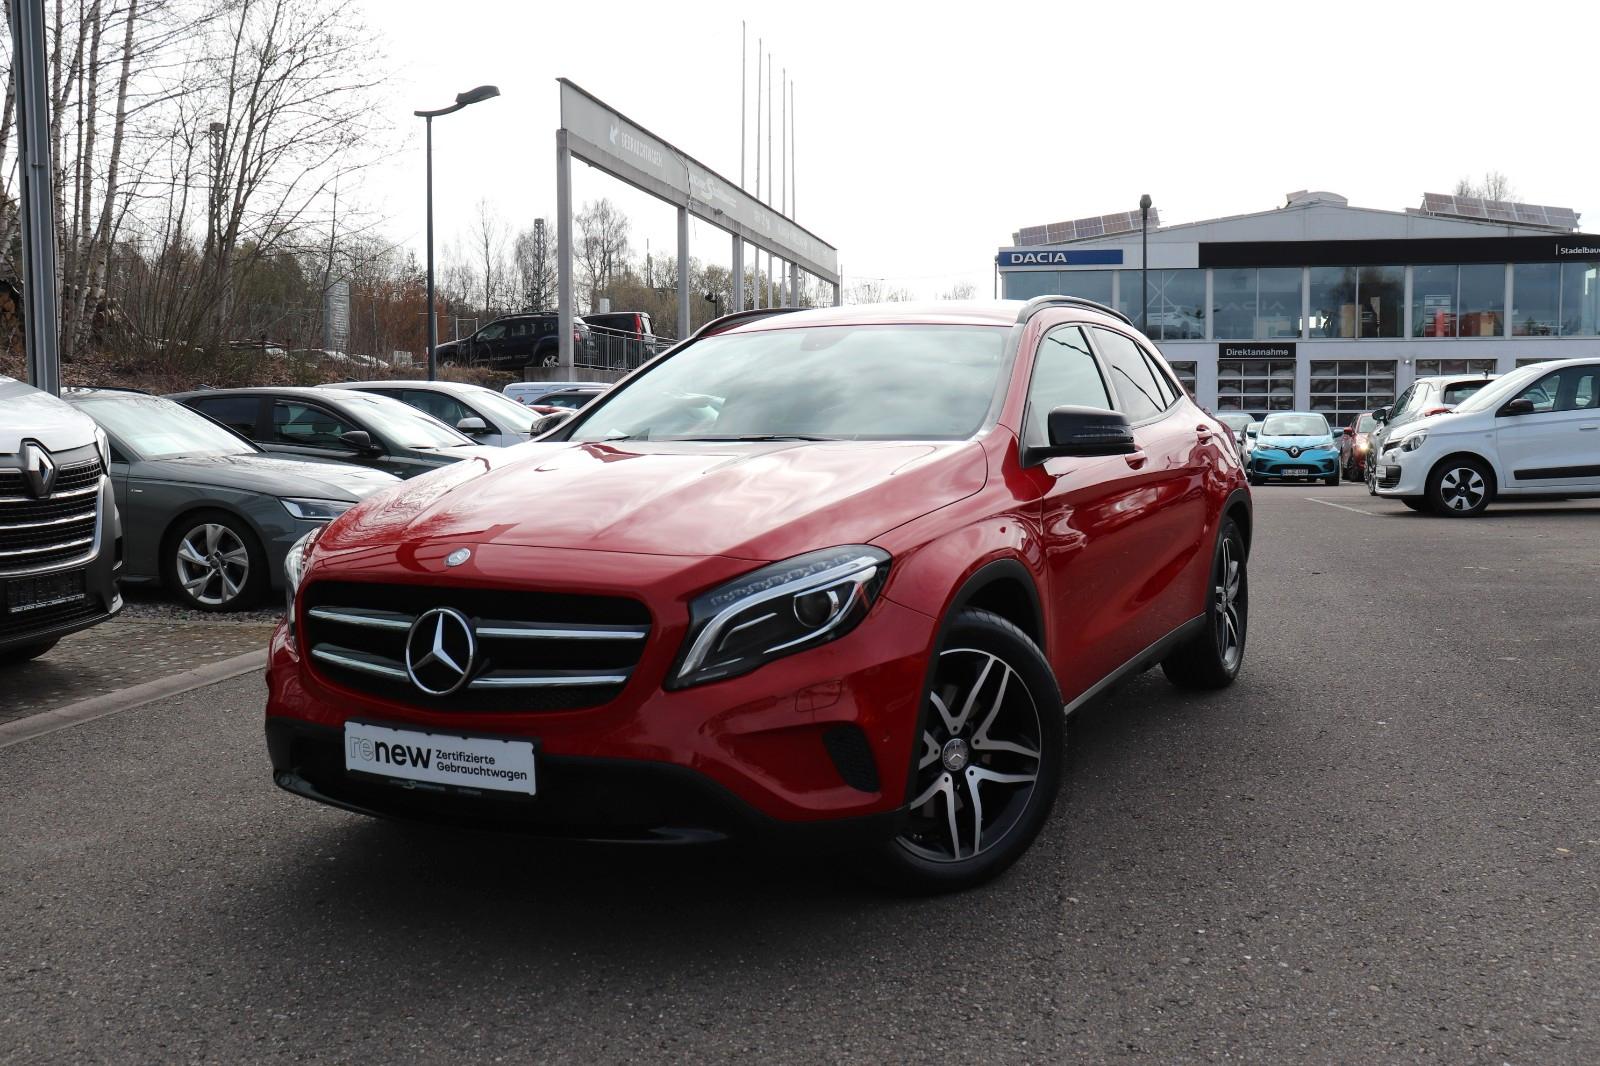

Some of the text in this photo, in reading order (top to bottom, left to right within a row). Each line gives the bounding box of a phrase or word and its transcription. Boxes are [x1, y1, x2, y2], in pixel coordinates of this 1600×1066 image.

[1011, 252, 1067, 263] DACIA
[1226, 348, 1289, 356] Direktannahme
[350, 736, 432, 769] renew
[436, 749, 495, 765] Zertifizierte
[436, 762, 528, 781] Gebrauchtwagen
